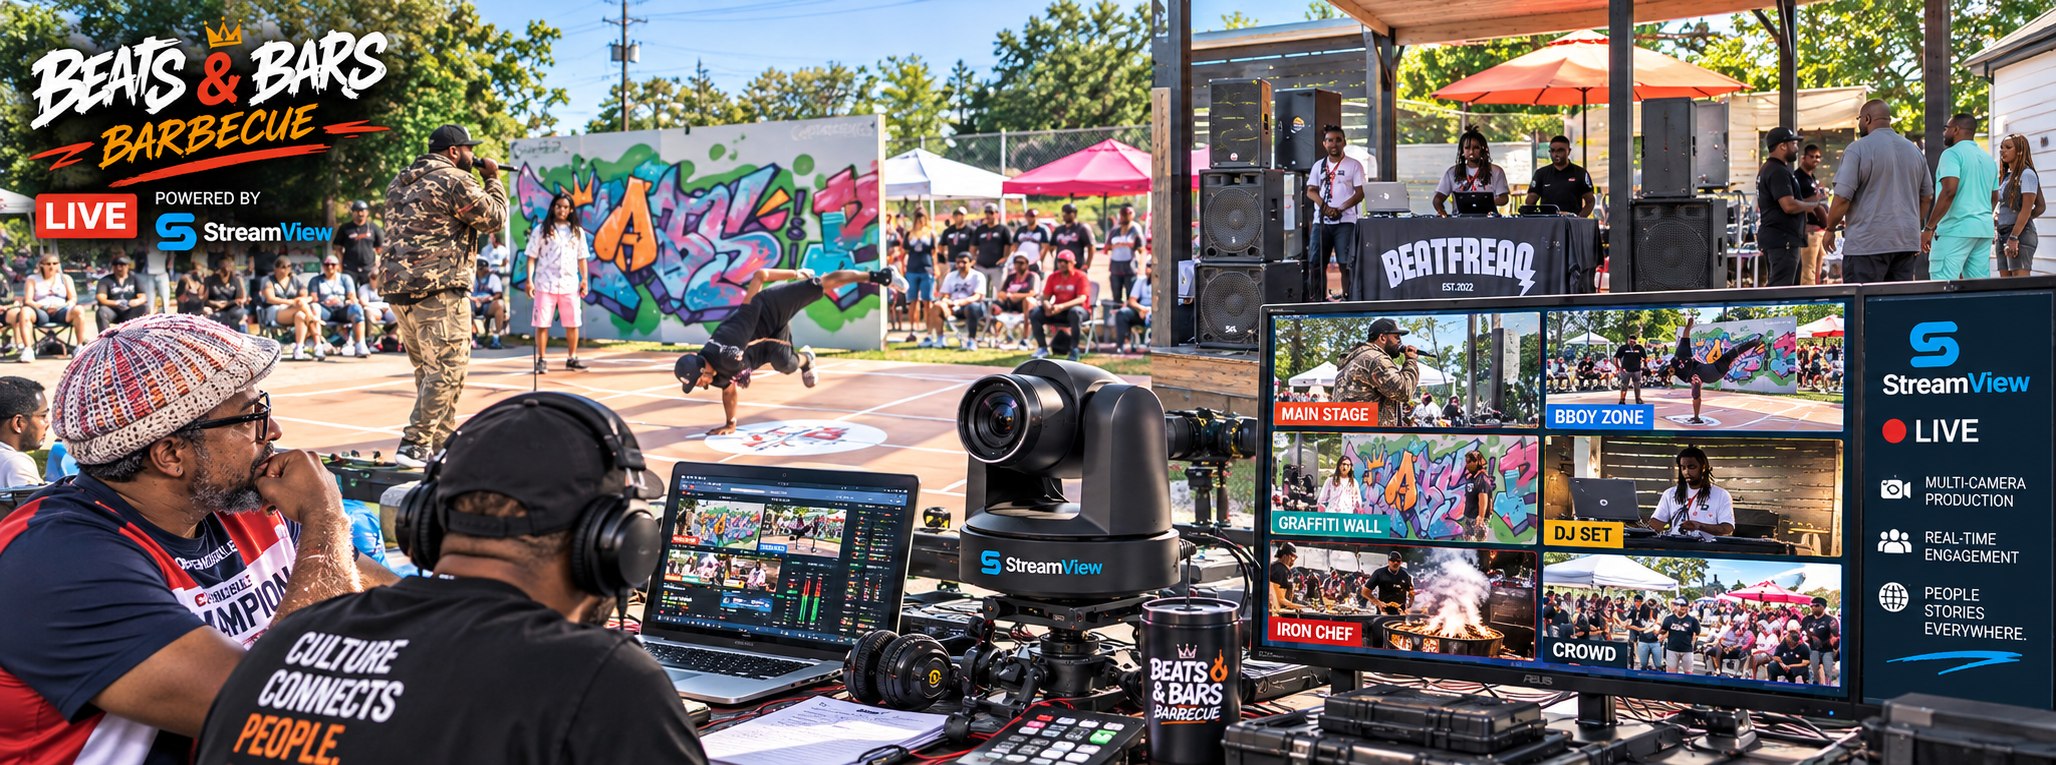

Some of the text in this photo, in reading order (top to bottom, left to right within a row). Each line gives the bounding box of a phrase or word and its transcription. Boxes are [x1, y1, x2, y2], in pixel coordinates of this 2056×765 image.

[1381, 237, 1536, 297] BEATFREAQ
[1442, 282, 1474, 292] EST.2022
[1882, 372, 2031, 395] StreamView
[1281, 407, 1369, 421] MAIN STAGE
[1555, 409, 1644, 425] BBOY ZONE
[1915, 418, 1979, 443] LIVE
[1925, 476, 2026, 490] MULTI-CAMERA
[1925, 493, 2014, 507] PRODUCTION
[1278, 516, 1382, 534] GRAFFITI WALL
[1554, 525, 1612, 542] DJ SET
[1925, 531, 1996, 546] REAL-TIME
[1924, 549, 2019, 564] ENGAGEMENT
[1005, 557, 1103, 576] StreamView
[1924, 587, 1980, 602] PEOPLE
[1924, 603, 1985, 620] STORIES
[1276, 622, 1354, 641] IRON CHEF
[1924, 622, 2027, 641] EVERYWHERE.
[285, 631, 410, 674] CULTURE
[1552, 642, 1617, 662] CROWD
[1149, 657, 1208, 683] BEATS
[257, 669, 404, 723] CONNECTS
[1152, 681, 1223, 705] & BARS
[232, 713, 346, 765] PEOPLE.
